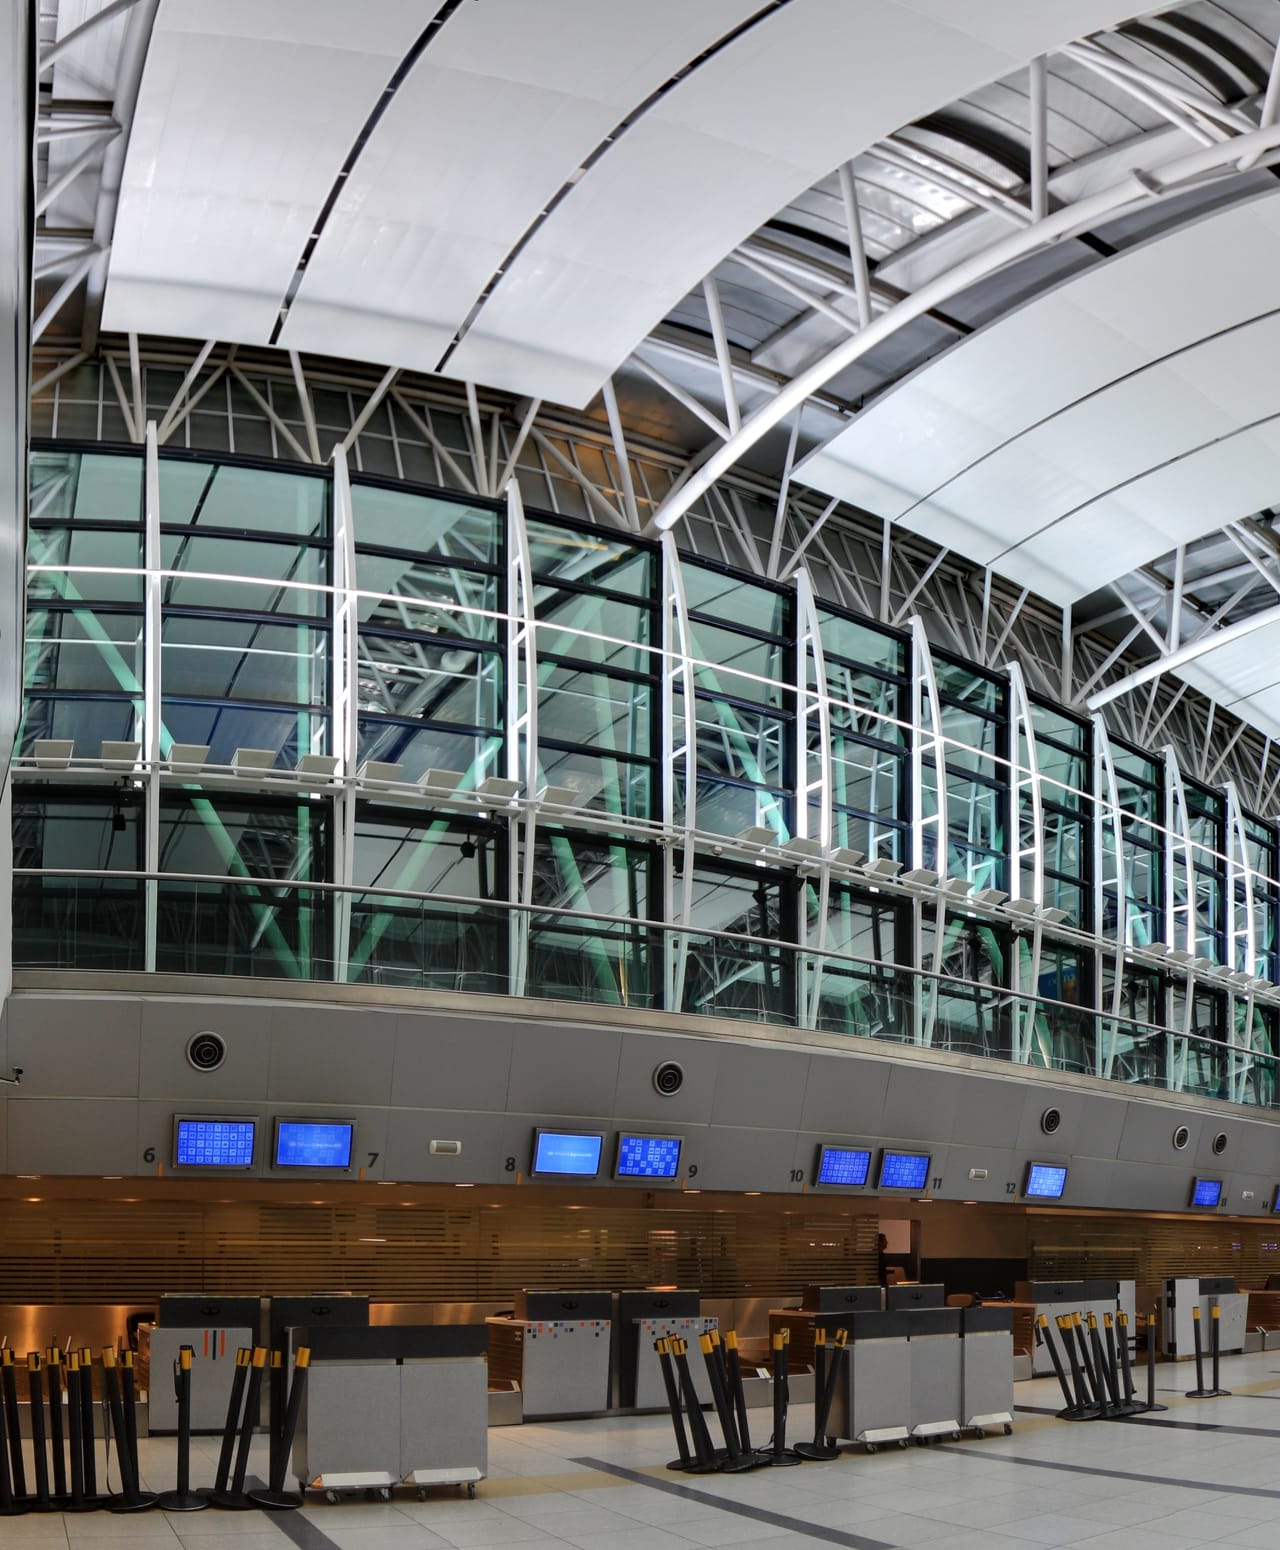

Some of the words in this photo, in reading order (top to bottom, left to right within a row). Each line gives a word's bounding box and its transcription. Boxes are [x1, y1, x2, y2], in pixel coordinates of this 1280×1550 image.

[143, 1147, 156, 1163] 6
[367, 1152, 379, 1168] 7
[505, 1157, 515, 1172] 8
[688, 1164, 698, 1178] 9
[790, 1170, 804, 1182] 10
[933, 1178, 942, 1189] 11
[1006, 1182, 1016, 1194] 12
